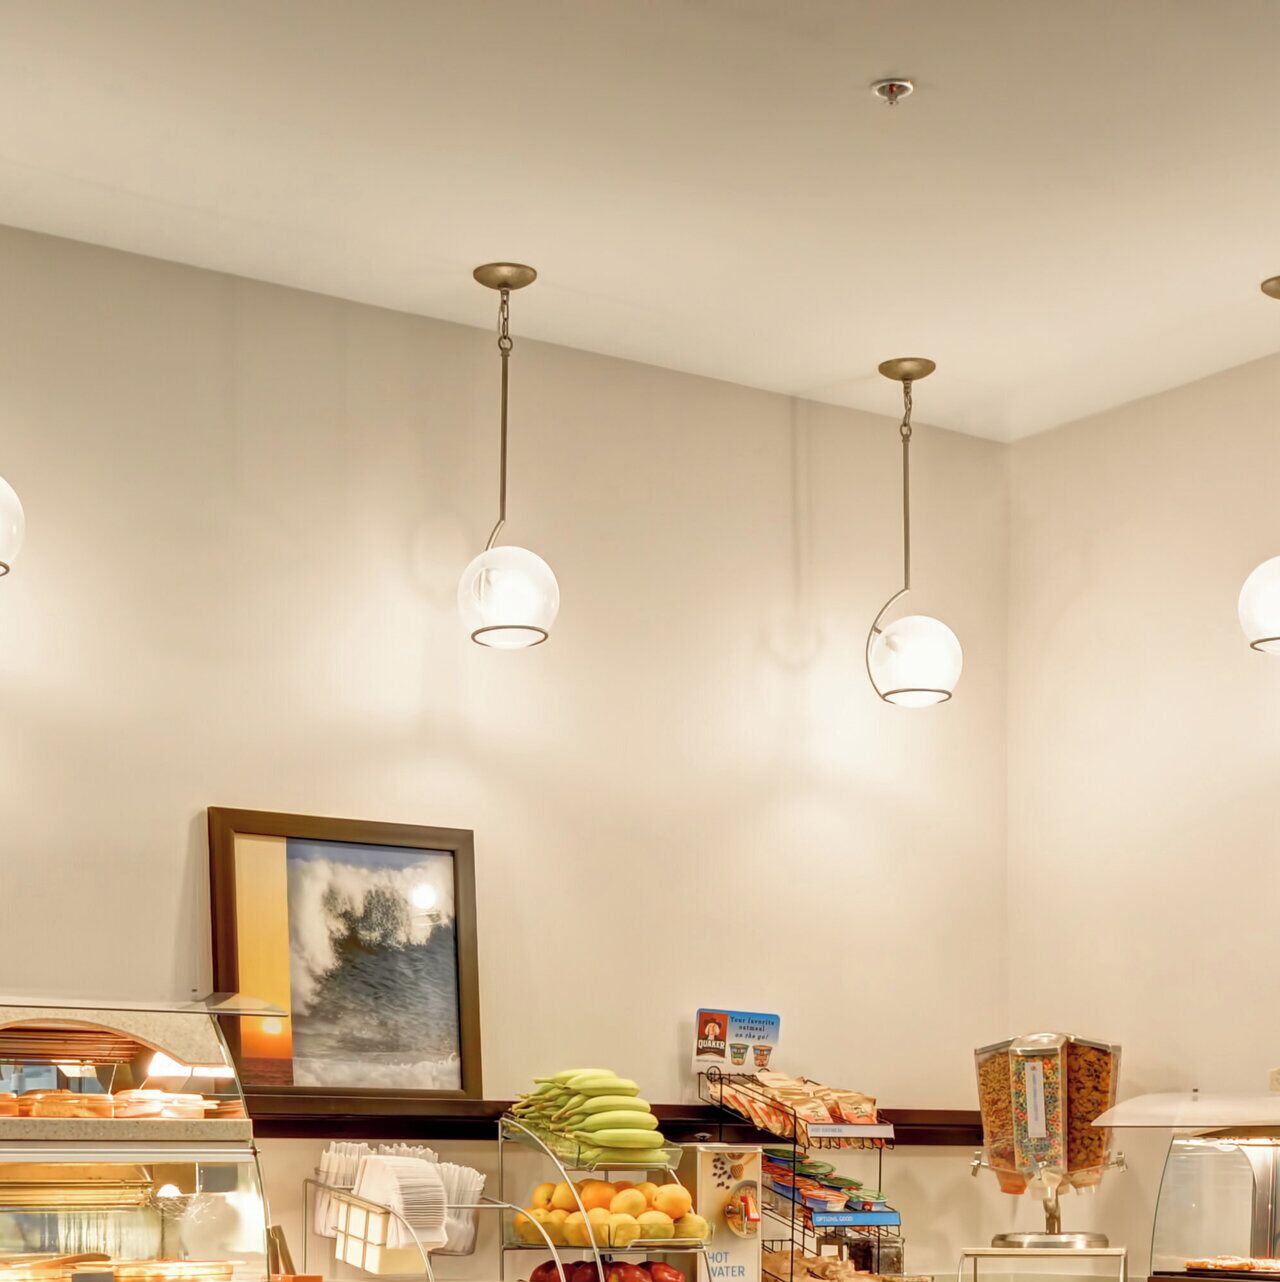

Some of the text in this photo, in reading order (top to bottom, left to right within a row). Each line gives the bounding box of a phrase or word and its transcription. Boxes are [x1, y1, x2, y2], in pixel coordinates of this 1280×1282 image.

[747, 1016, 775, 1025] favorite
[698, 1040, 726, 1049] QUAKER
[708, 1251, 730, 1264] HOT
